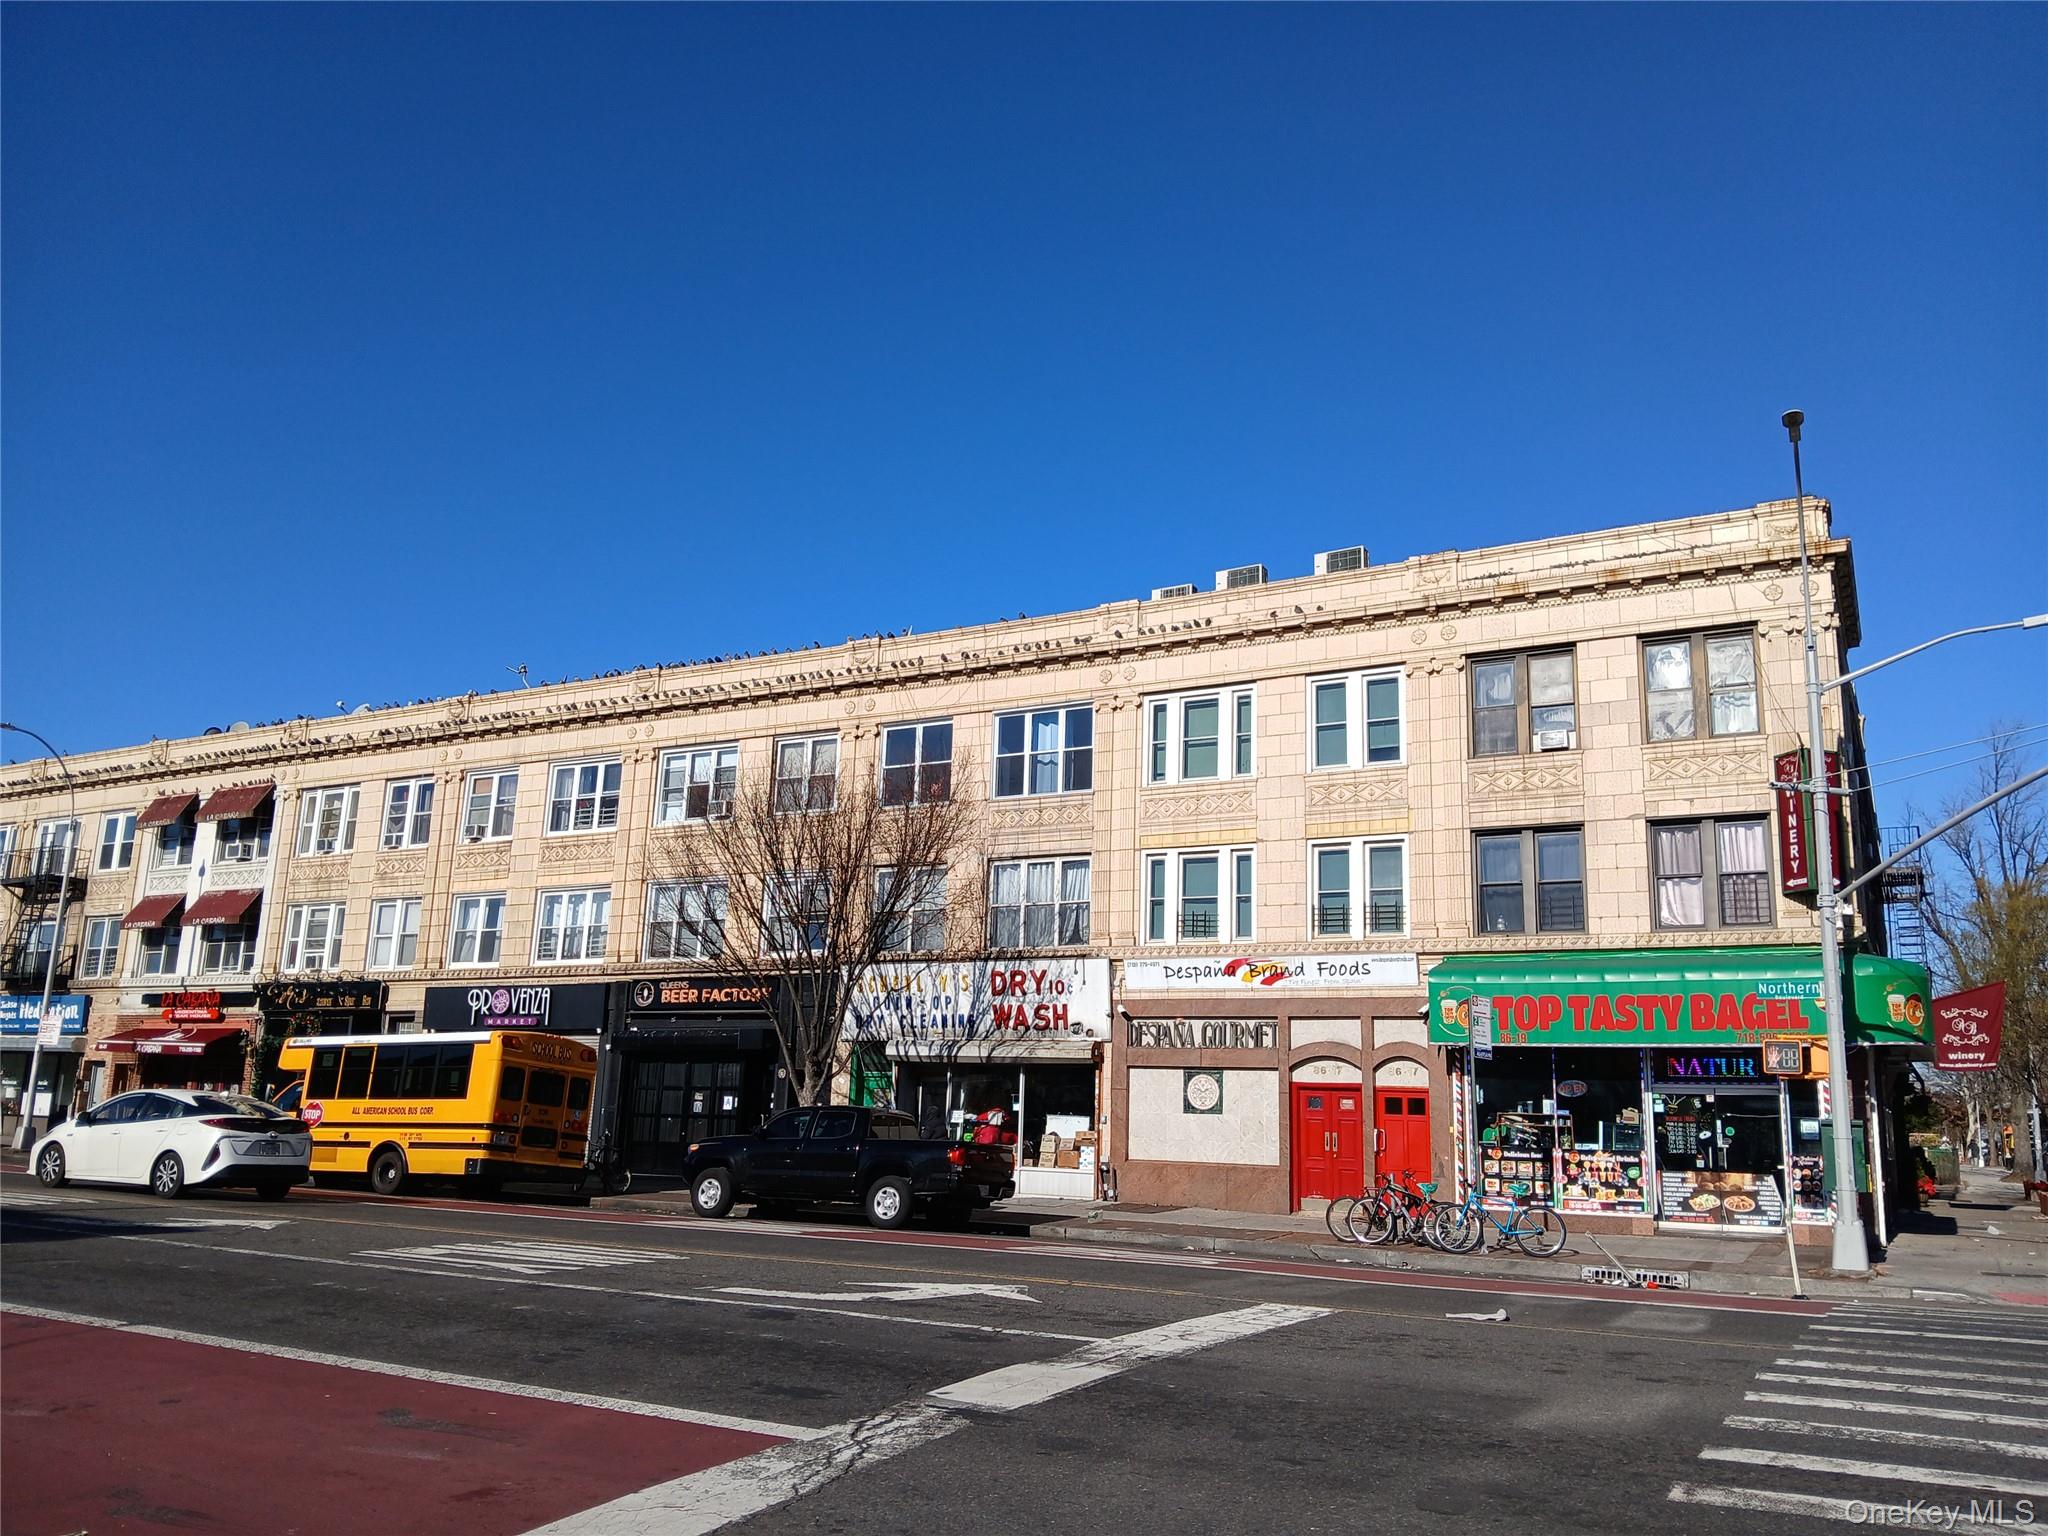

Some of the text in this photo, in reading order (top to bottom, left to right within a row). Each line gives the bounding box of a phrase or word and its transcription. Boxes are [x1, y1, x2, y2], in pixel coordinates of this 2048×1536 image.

[1163, 960, 1371, 984] Despaña Brand Foods
[659, 980, 690, 989] QUEENS
[991, 970, 1047, 997] DRY
[1758, 981, 1820, 994] Northern
[661, 987, 772, 1003] BEER FACTORY
[468, 987, 551, 1026] PROVENZA
[1492, 995, 1563, 1031] TOP
[1567, 994, 1684, 1031] TASTY
[1690, 993, 1810, 1030] BAGEL
[487, 1018, 534, 1026] MARKET
[992, 1003, 1069, 1031] WASH
[1128, 1018, 1278, 1048] DESPAÑA GOURMET
[1500, 1033, 1527, 1044] 86-19
[1948, 1051, 1985, 1060] winery
[1668, 1058, 1755, 1076] NATUR
[1559, 1083, 1586, 1093] OPEN
[304, 1108, 321, 1120] STOP
[352, 1106, 360, 1115] ALL
[363, 1106, 387, 1115] AMERICAN
[387, 1106, 407, 1115] SCHOOL
[408, 1106, 418, 1115] BUS
